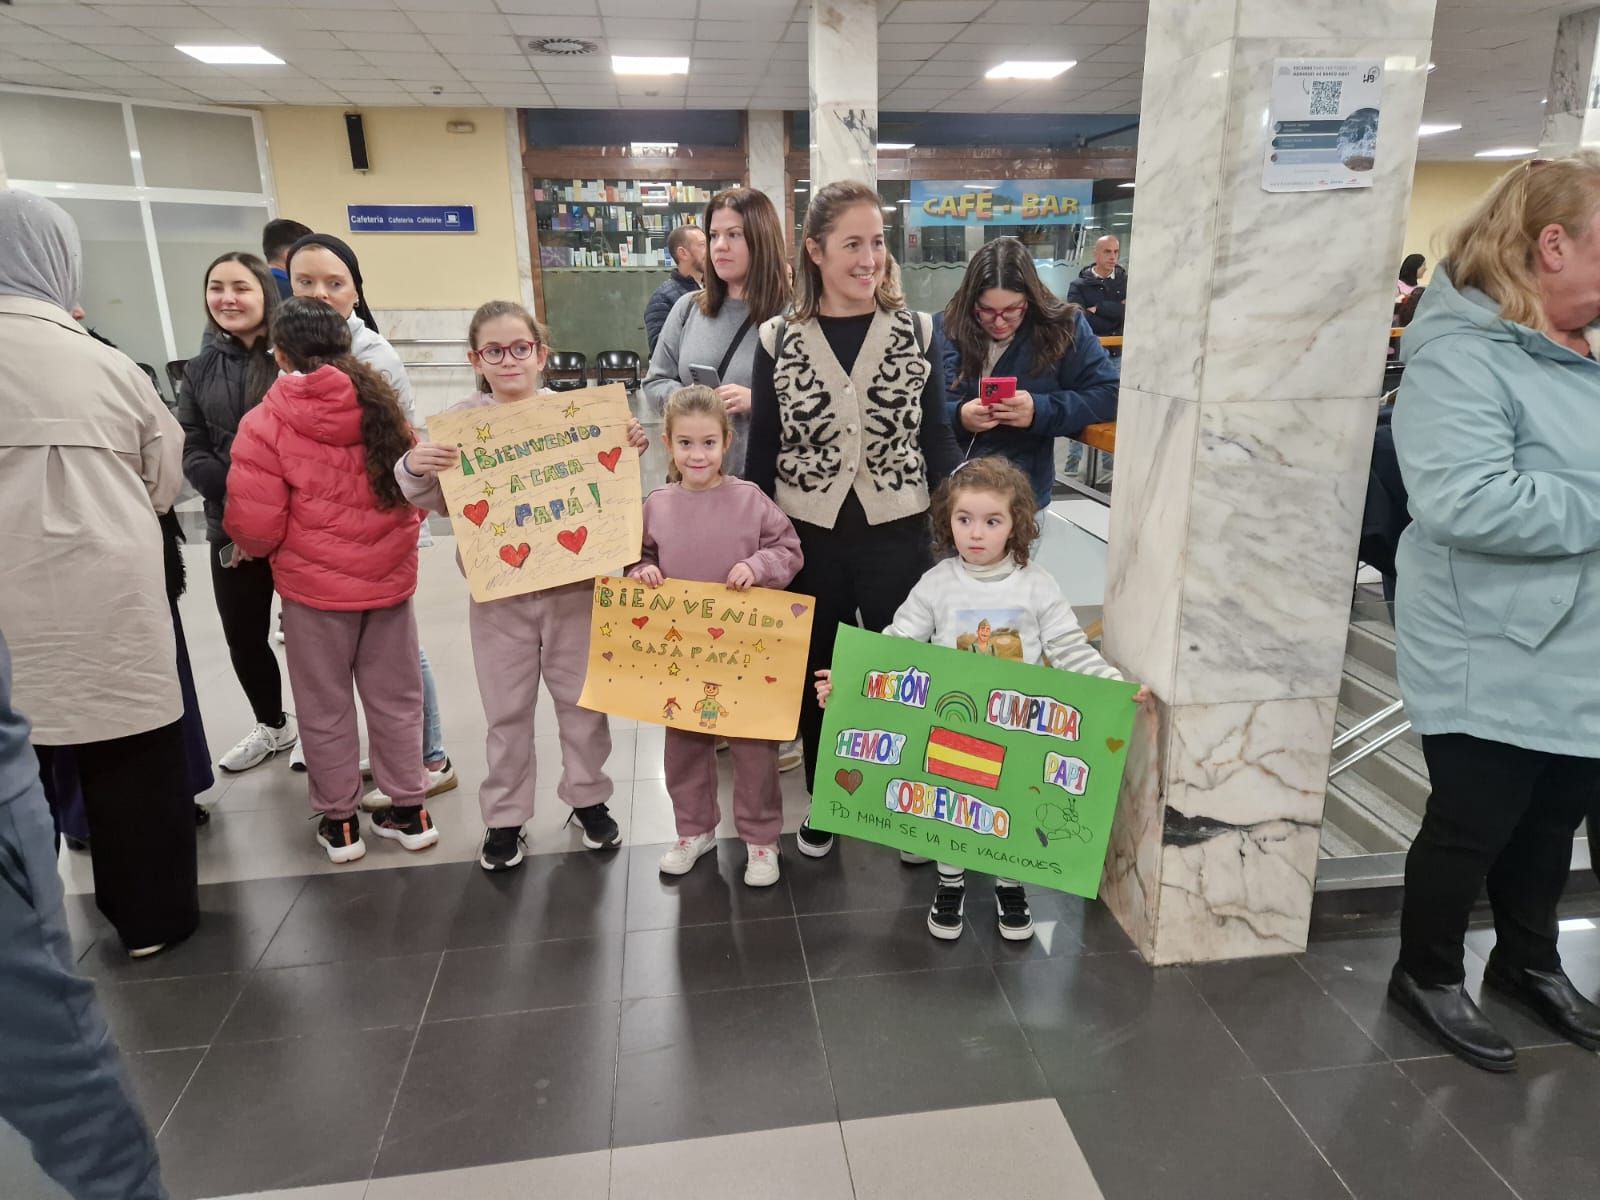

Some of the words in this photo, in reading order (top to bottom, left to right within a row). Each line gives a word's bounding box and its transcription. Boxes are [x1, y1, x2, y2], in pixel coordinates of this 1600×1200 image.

[350, 215, 384, 224] Cafeteria
[1021, 192, 1079, 219] BAR
[510, 474, 525, 493] A
[530, 458, 584, 487] CASA
[631, 639, 684, 658] CASA
[866, 668, 930, 706] MISIÓN
[987, 691, 1079, 741] CUMPLIDA
[838, 731, 903, 763] HEMOS
[1046, 755, 1087, 791] PAPI
[888, 780, 1009, 837] SOBREVIVIDO
[830, 800, 850, 819] PD
[900, 823, 918, 838] SE
[926, 832, 940, 846] VA
[950, 839, 968, 853] DE
[977, 847, 1063, 875] VACACIONES
